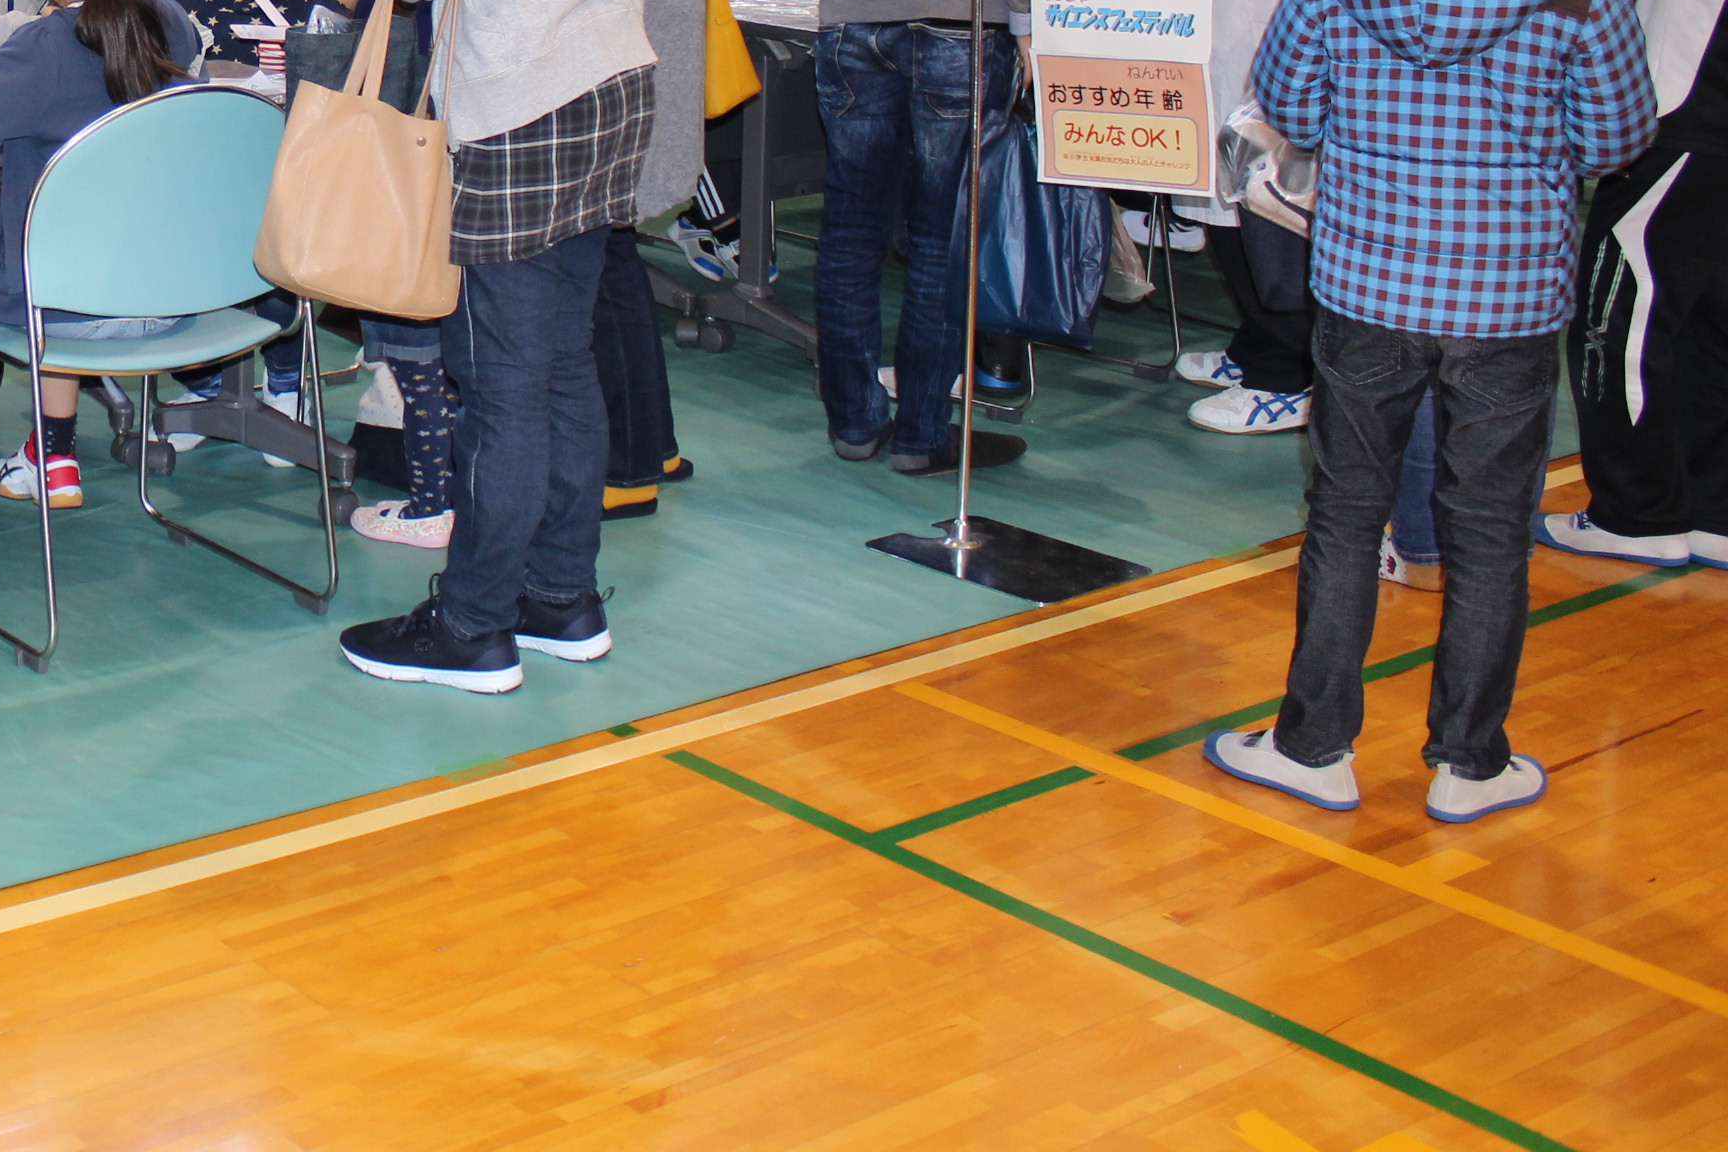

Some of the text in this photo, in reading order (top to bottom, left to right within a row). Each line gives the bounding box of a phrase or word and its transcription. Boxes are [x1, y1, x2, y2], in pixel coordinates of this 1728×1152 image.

[1044, 4, 1196, 38] サイエンスフェスティバル
[1127, 65, 1184, 81] ねんれい
[1047, 82, 1183, 112] おすすめ年齢
